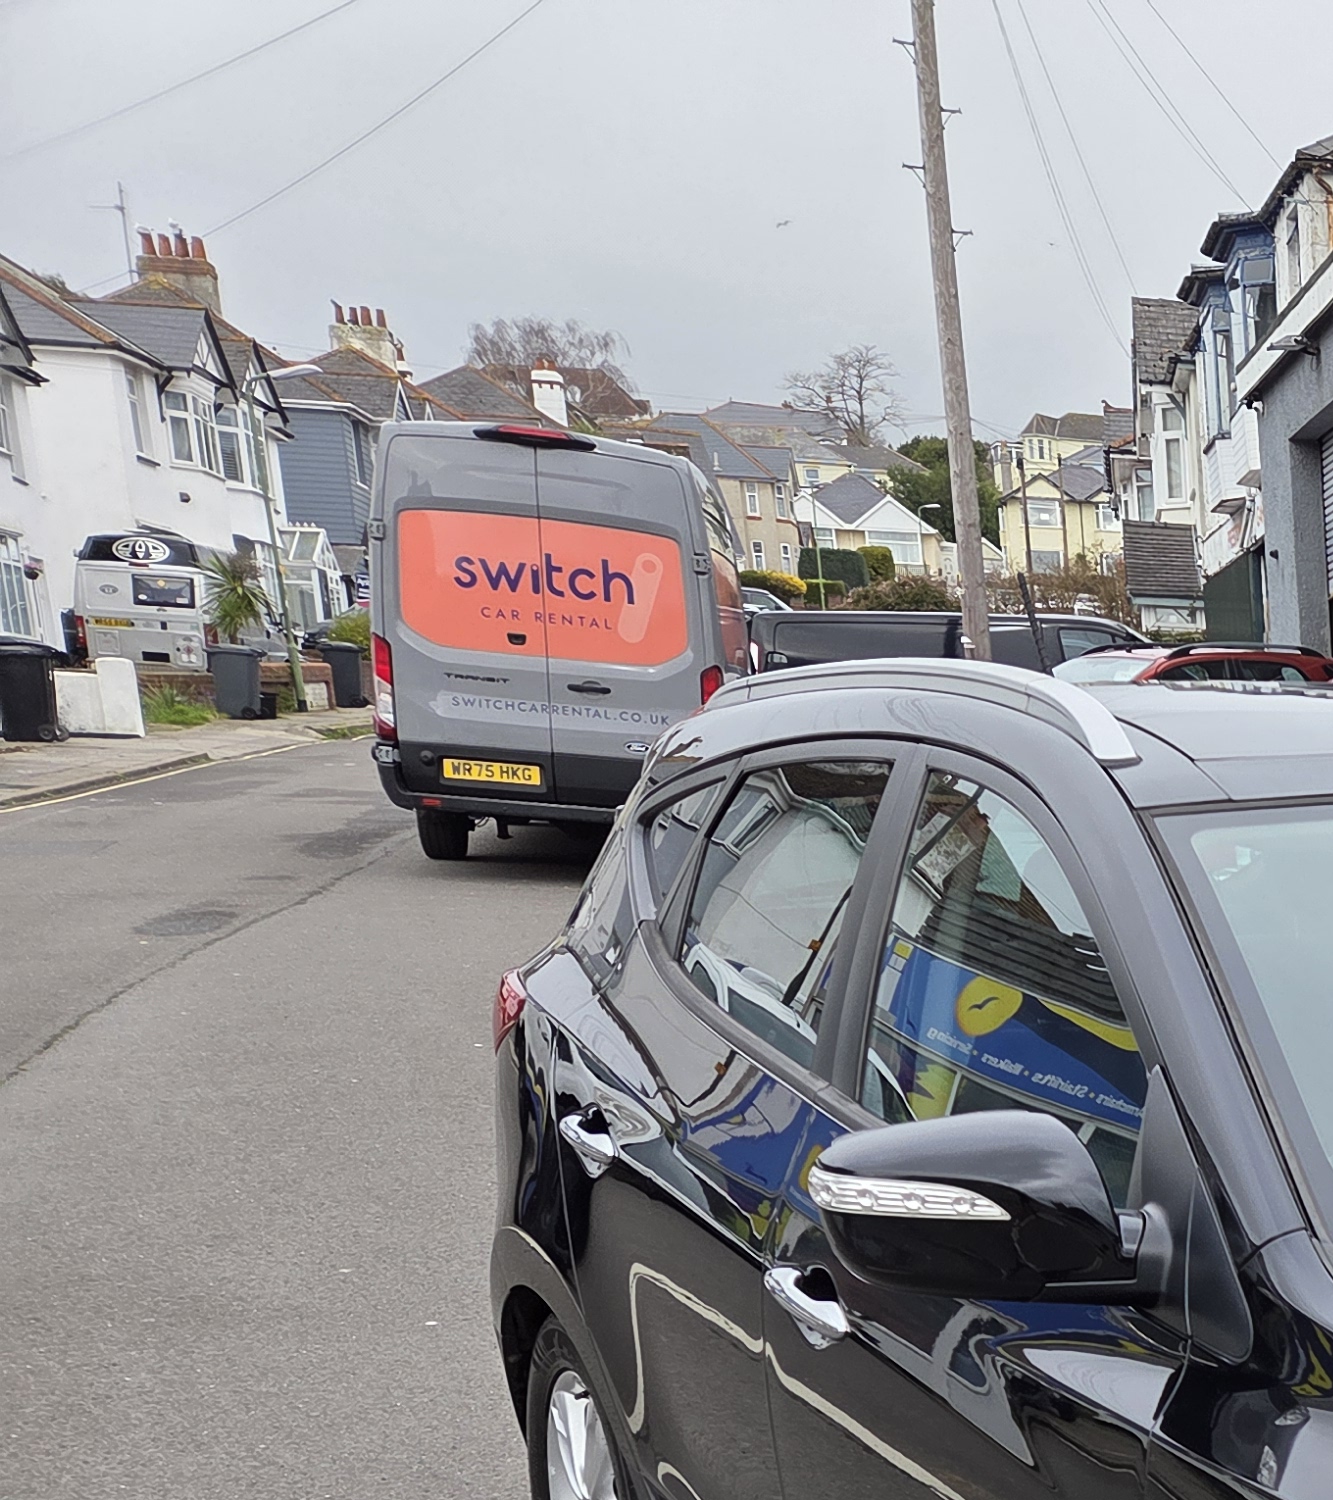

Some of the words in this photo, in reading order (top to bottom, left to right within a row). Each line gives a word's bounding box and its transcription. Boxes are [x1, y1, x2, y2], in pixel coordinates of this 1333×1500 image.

[453, 553, 635, 605] switch
[480, 606, 521, 621] CAR
[534, 611, 613, 630] RENTAL
[443, 672, 511, 684] TRANSIT
[451, 695, 670, 726] SWITCHCARRENTAL.CO.UK
[451, 761, 495, 778] WR75
[499, 765, 532, 781] HKG
